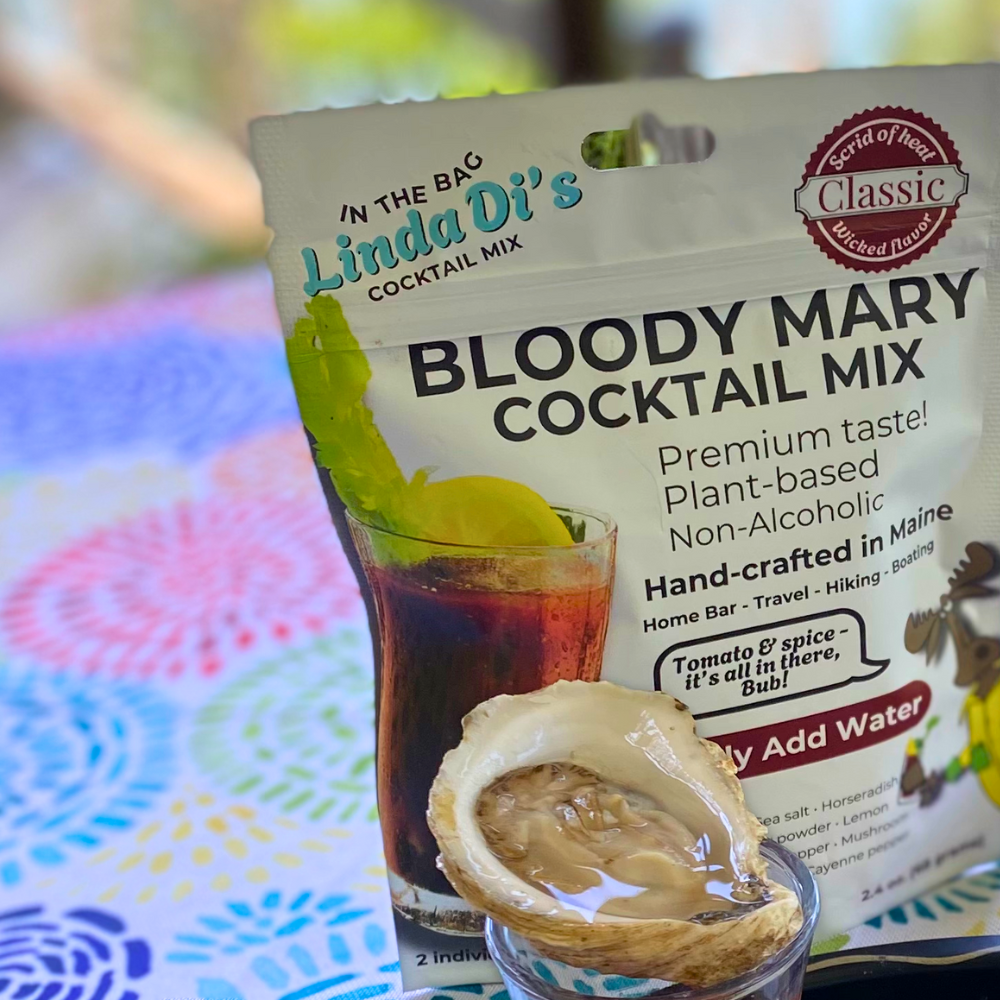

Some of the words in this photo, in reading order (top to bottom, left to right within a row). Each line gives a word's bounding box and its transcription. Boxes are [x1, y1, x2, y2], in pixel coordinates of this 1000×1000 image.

[829, 128, 874, 171] Scrid
[877, 125, 899, 146] of
[898, 128, 936, 163] heat
[339, 204, 368, 224] IN
[373, 185, 428, 214] THE
[433, 151, 483, 193] BAG
[818, 170, 945, 213] Classic
[301, 208, 467, 297] Linda
[465, 165, 583, 232] Di's
[832, 220, 887, 256] Wicked
[891, 212, 932, 257] flavor
[368, 253, 478, 302] COCKTAIL
[480, 233, 524, 262] MIX
[407, 300, 747, 399] BLOODY
[771, 267, 981, 348] MARY
[492, 359, 808, 443] COCKTAIL
[821, 337, 927, 405] MIX
[658, 424, 831, 475] Premium
[840, 401, 929, 444] taste!
[664, 449, 880, 514] Plant-based
[644, 538, 852, 601] Hand-crafted
[861, 534, 884, 558] in
[889, 503, 954, 546] Maine
[669, 490, 885, 552] Non-Alcoholic
[643, 610, 700, 633] Home
[705, 603, 737, 621] Bar
[753, 585, 810, 610] Travel
[825, 570, 881, 595] Hiking
[891, 540, 934, 575] Boating
[673, 643, 754, 675] Tomato
[781, 628, 836, 653] spice
[685, 668, 720, 691] it's
[724, 659, 751, 684] all
[756, 658, 777, 676] in
[780, 645, 841, 671] there,
[740, 670, 789, 697] Bub!
[724, 744, 753, 772] ly
[761, 724, 827, 762] Add
[835, 696, 923, 742] Water
[777, 822, 831, 844] powder
[843, 802, 889, 826] Lemon
[784, 806, 810, 822] salt
[821, 776, 898, 813] Horseradish
[797, 842, 830, 860] pper
[416, 953, 428, 966] 2
[433, 948, 493, 964] indivi
